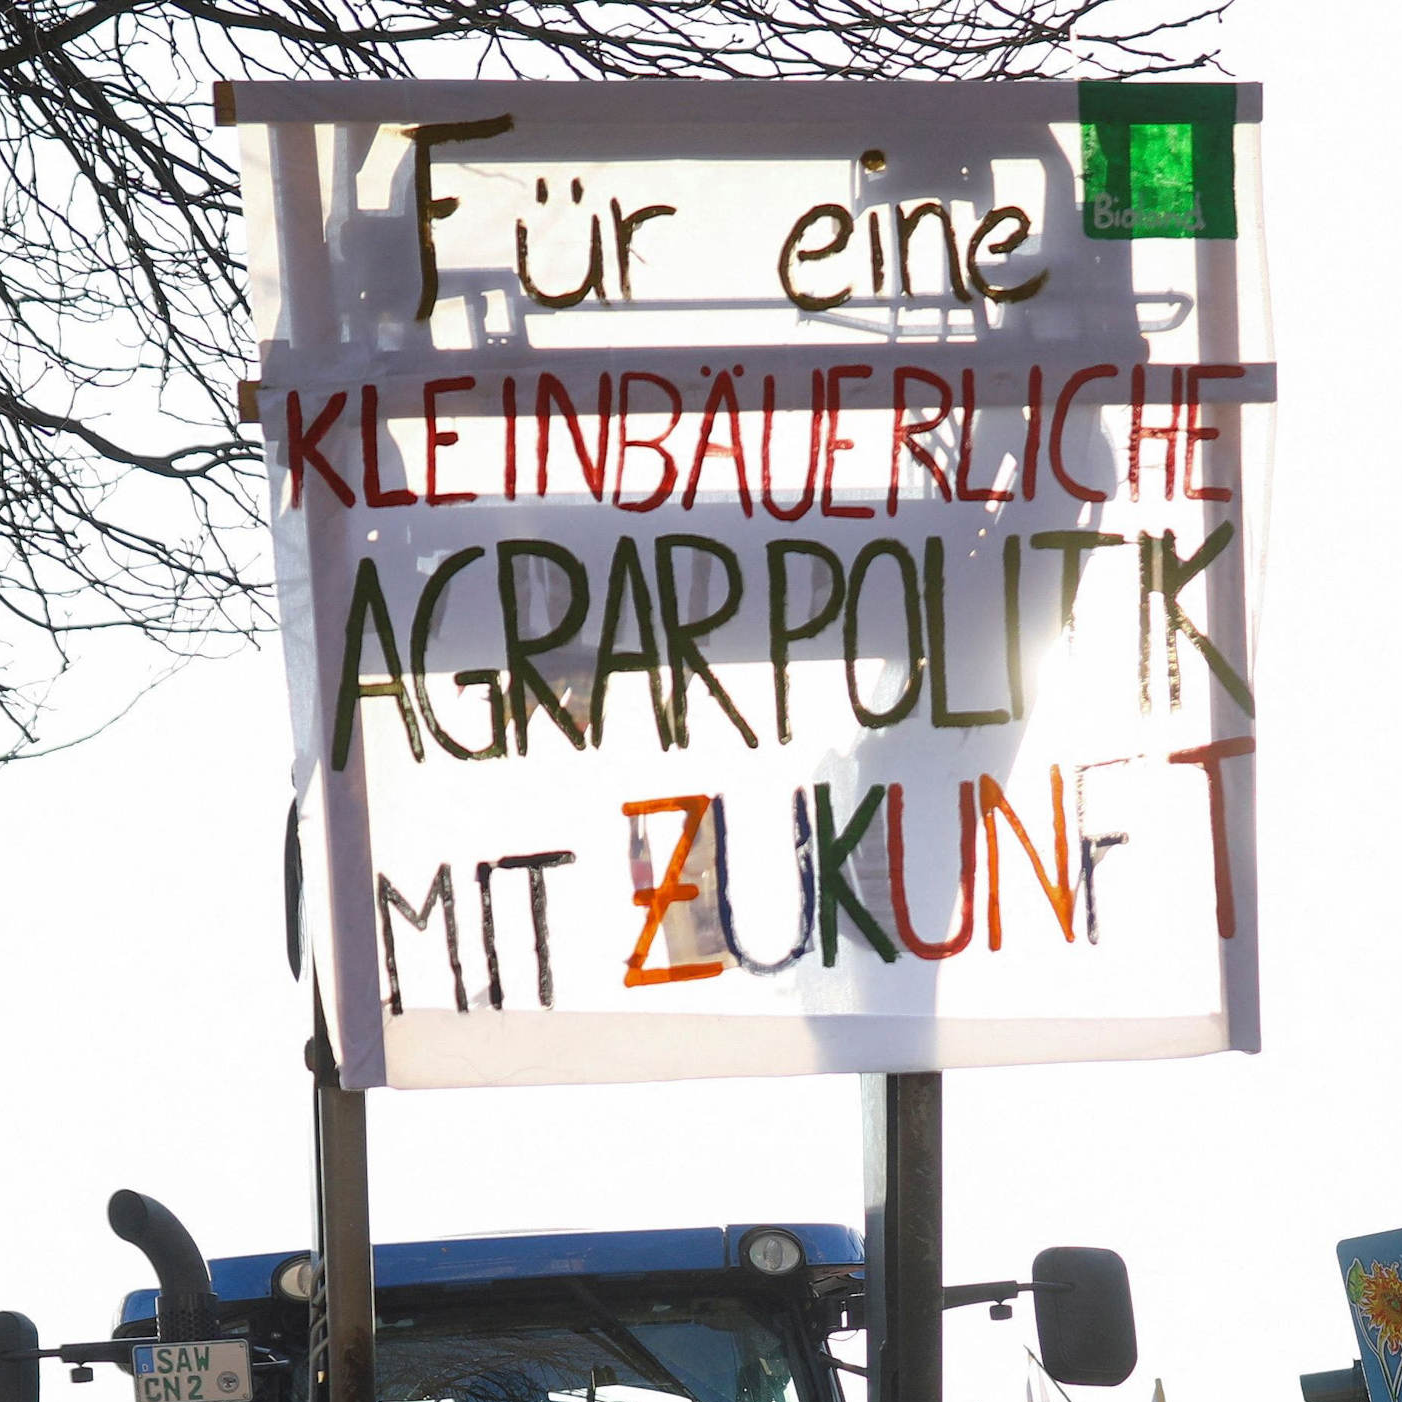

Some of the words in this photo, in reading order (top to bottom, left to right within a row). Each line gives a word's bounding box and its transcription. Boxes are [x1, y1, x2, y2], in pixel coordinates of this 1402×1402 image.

[402, 113, 676, 322] Für
[777, 149, 1051, 310] eine
[285, 362, 1247, 520] KLEINBÄUERLICHE
[330, 520, 1256, 773] AGRARPOLITIK
[379, 850, 576, 1015] MIT
[623, 736, 1257, 988] ZUKUNFT
[144, 1376, 181, 1402] CN
[187, 1375, 203, 1401] 2
[156, 1346, 210, 1374] SAW
